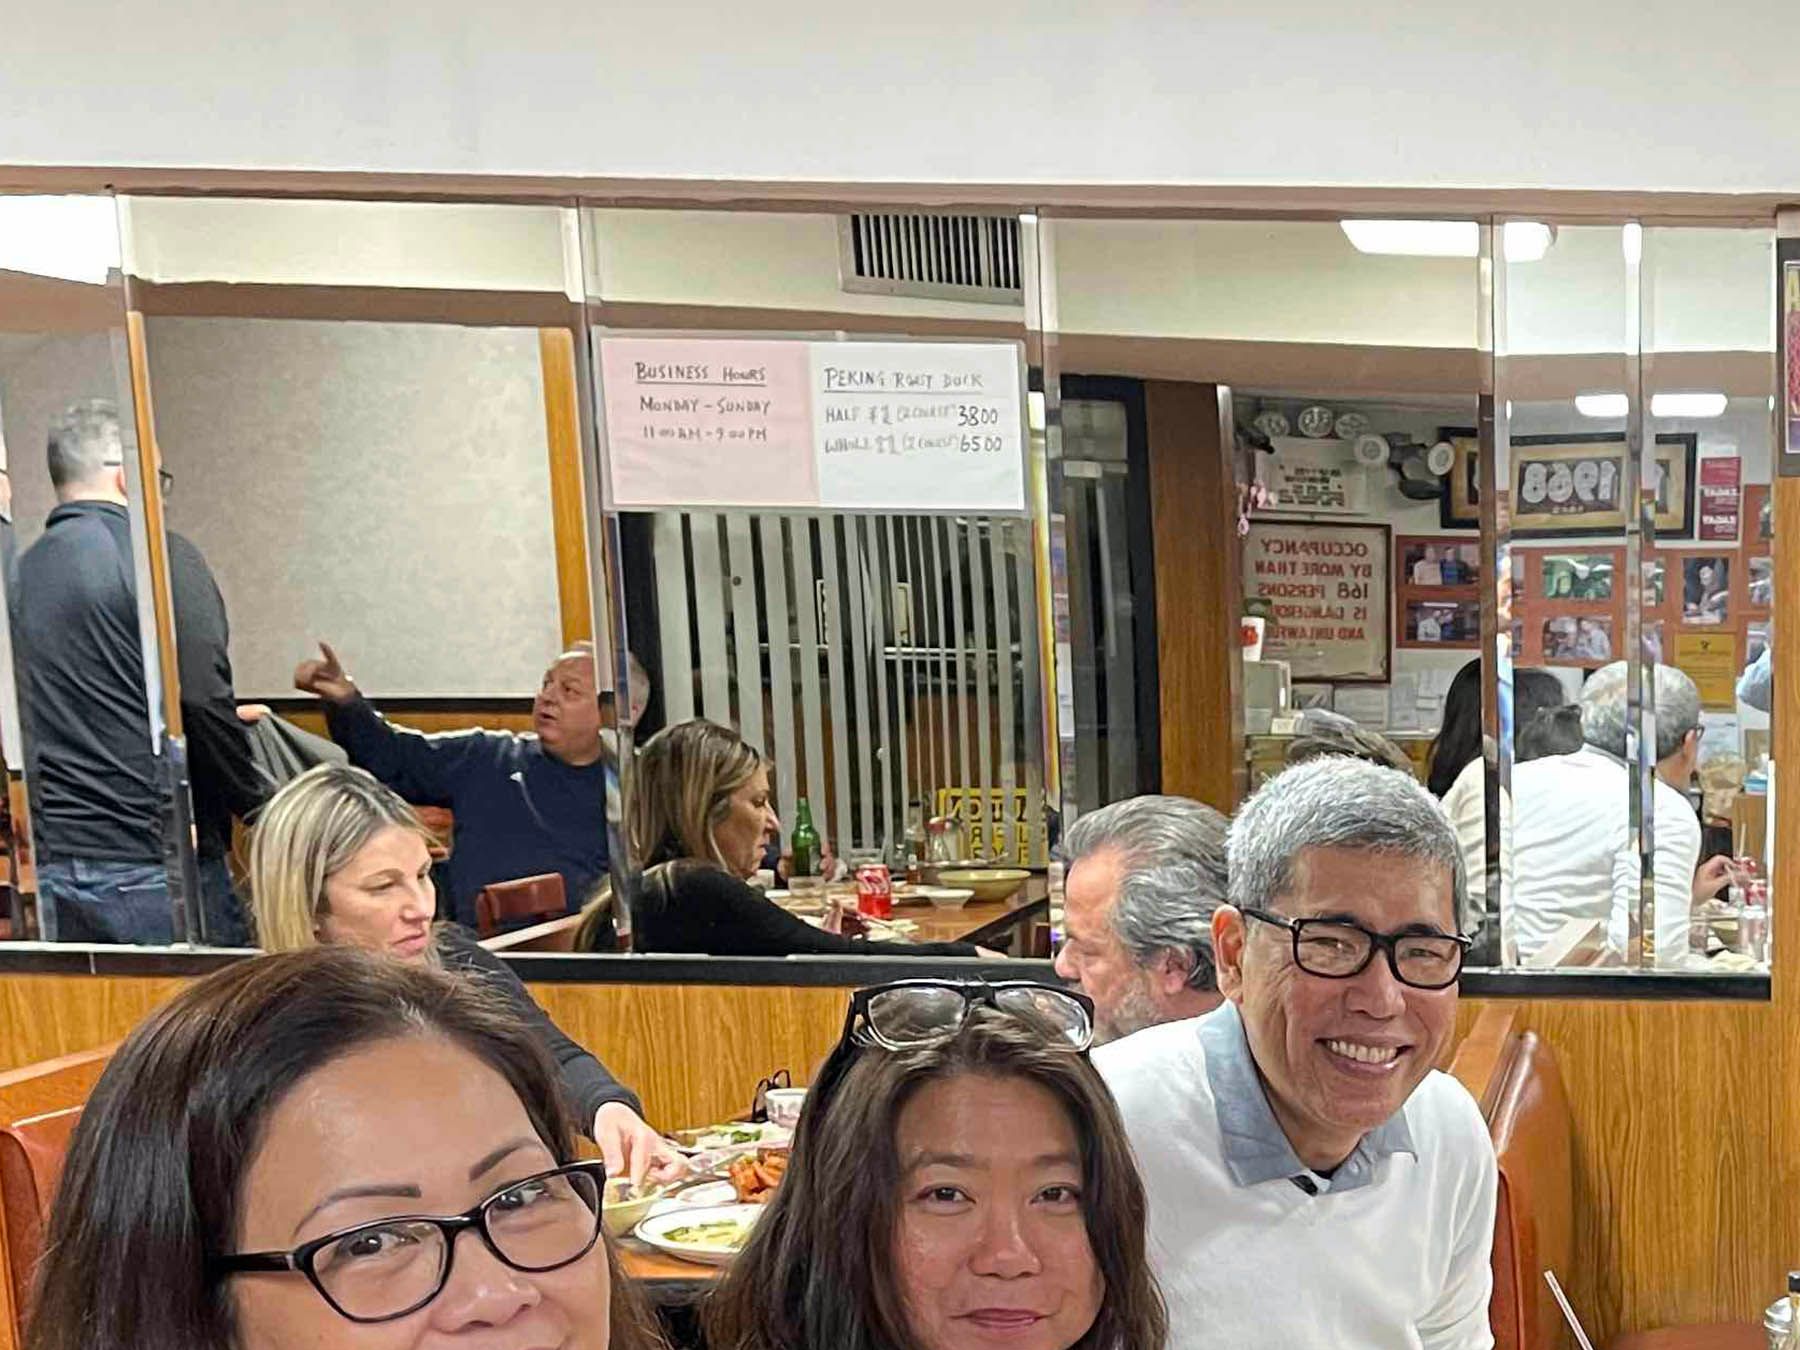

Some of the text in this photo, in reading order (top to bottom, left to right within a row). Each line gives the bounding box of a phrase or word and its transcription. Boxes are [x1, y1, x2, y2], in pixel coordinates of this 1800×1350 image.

[634, 361, 709, 381] BUSINESS
[823, 367, 886, 389] PEKING
[639, 395, 699, 412] MONDAY
[716, 397, 771, 415] SUNDAY
